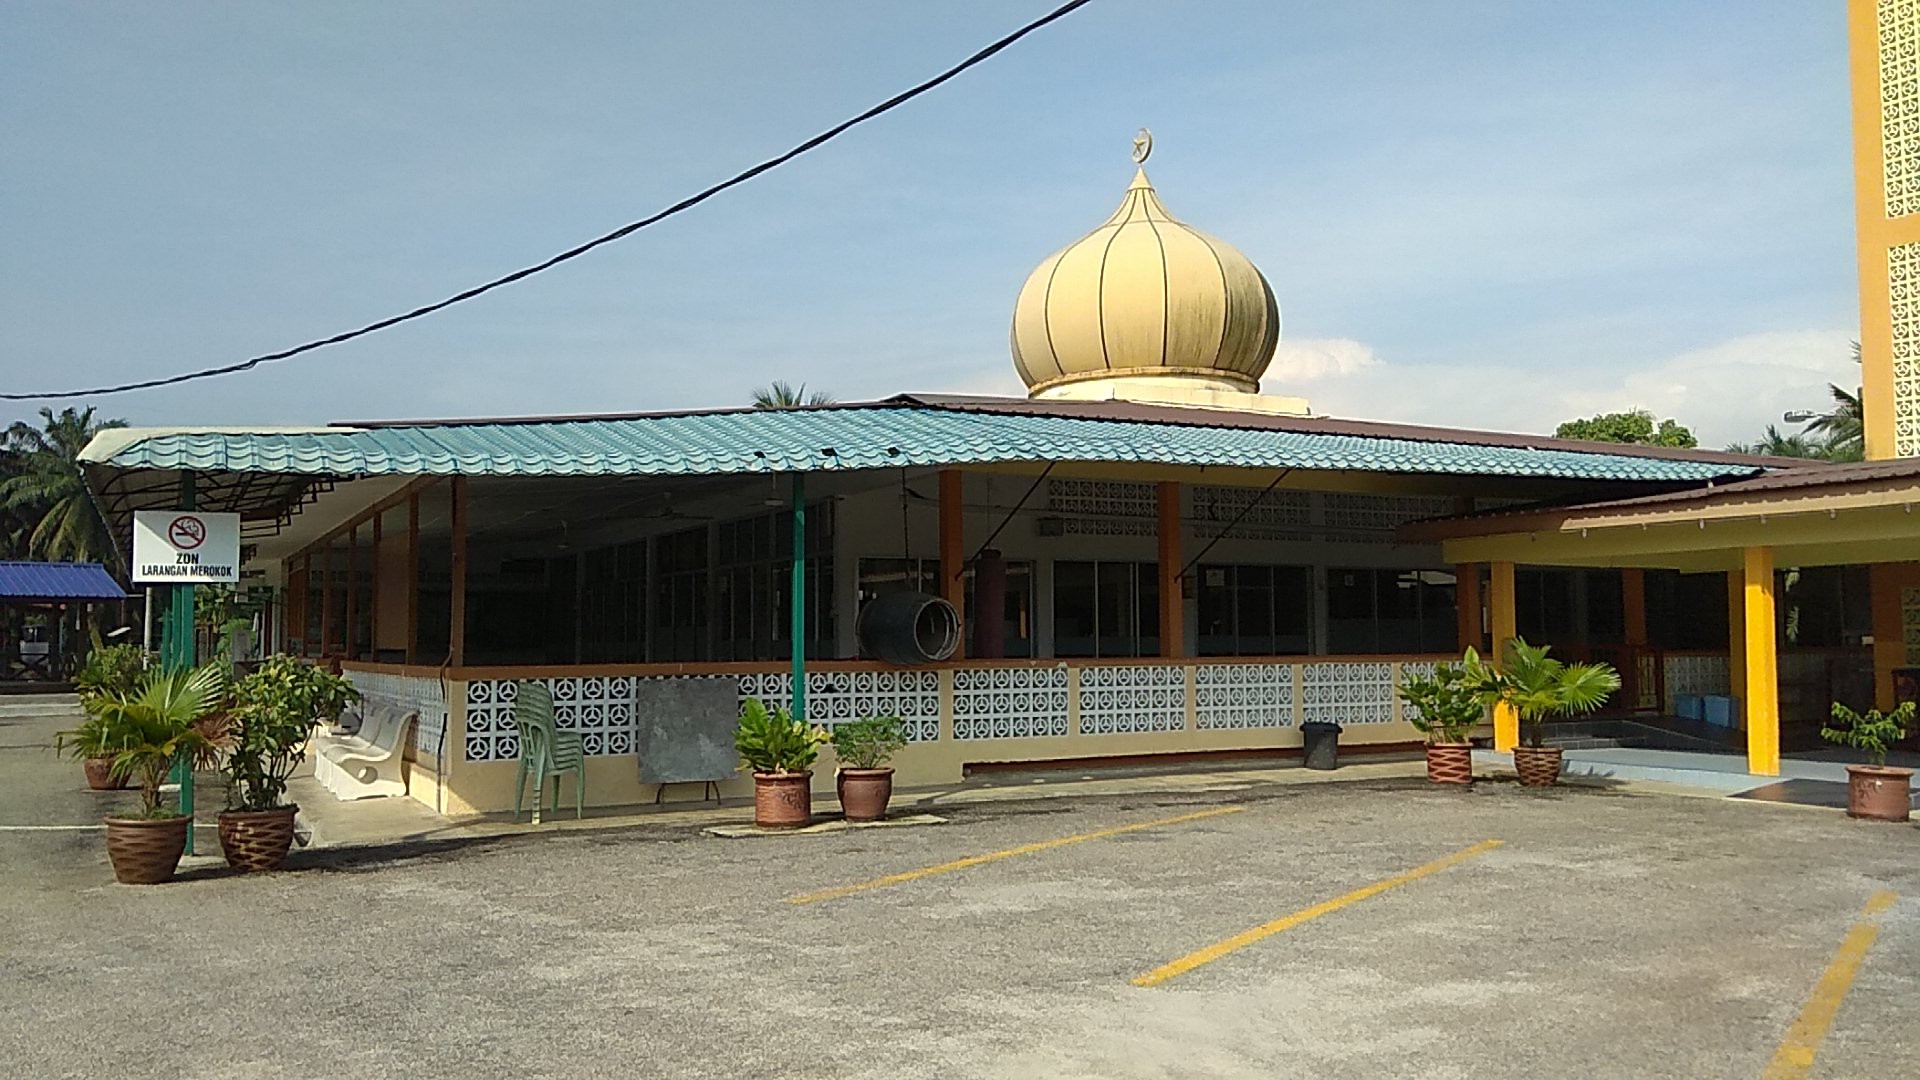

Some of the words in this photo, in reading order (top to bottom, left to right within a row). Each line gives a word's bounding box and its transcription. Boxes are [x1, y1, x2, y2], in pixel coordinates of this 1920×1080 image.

[176, 553, 199, 564] ZON
[142, 565, 187, 576] LARANGAN
[190, 565, 232, 577] MEROKOK
